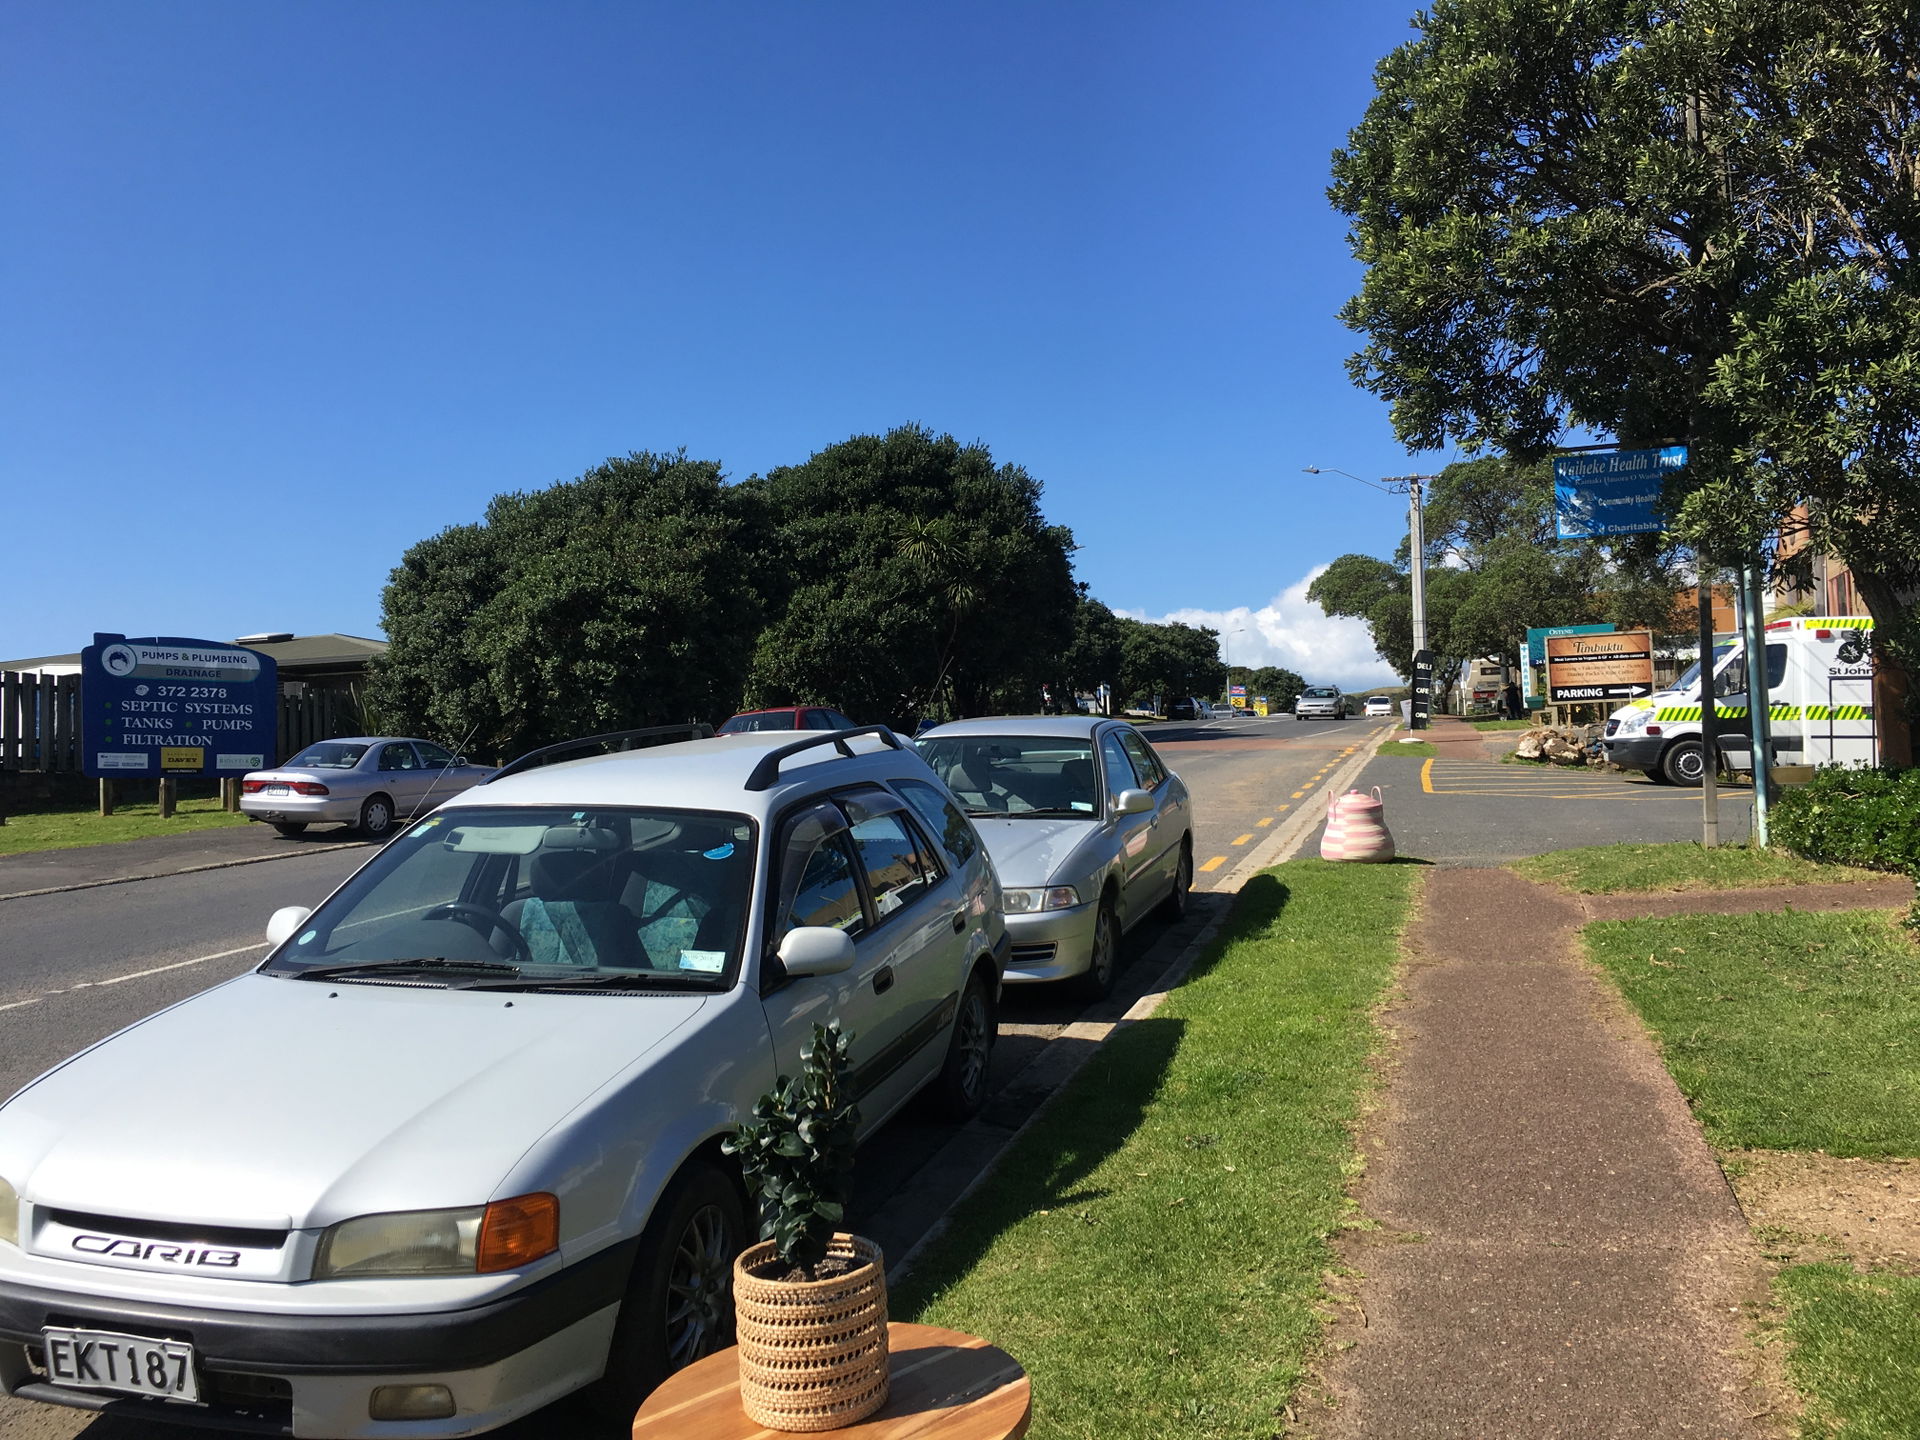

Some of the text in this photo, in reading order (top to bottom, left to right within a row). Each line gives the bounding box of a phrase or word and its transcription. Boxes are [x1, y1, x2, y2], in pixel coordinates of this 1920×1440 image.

[1558, 452, 1683, 477] Waiheke Health Trust
[1598, 496, 1634, 506] Community
[1635, 494, 1656, 503] Health
[1608, 522, 1658, 532] Charitable
[1572, 641, 1624, 653] Timbuktu
[142, 651, 248, 664] PUMPS & PLUMBING
[166, 668, 222, 678] DRAINAGE
[1522, 655, 1530, 696] PHARMA
[158, 686, 227, 698] 372 2378
[1556, 688, 1604, 698] PARKING
[121, 700, 253, 715] SEPTIC SYSTEMS
[122, 717, 253, 730] TANKS PUMPS
[122, 734, 213, 746] FILTRATION
[72, 1235, 241, 1267] CARIB
[50, 1337, 187, 1392] EKT187
